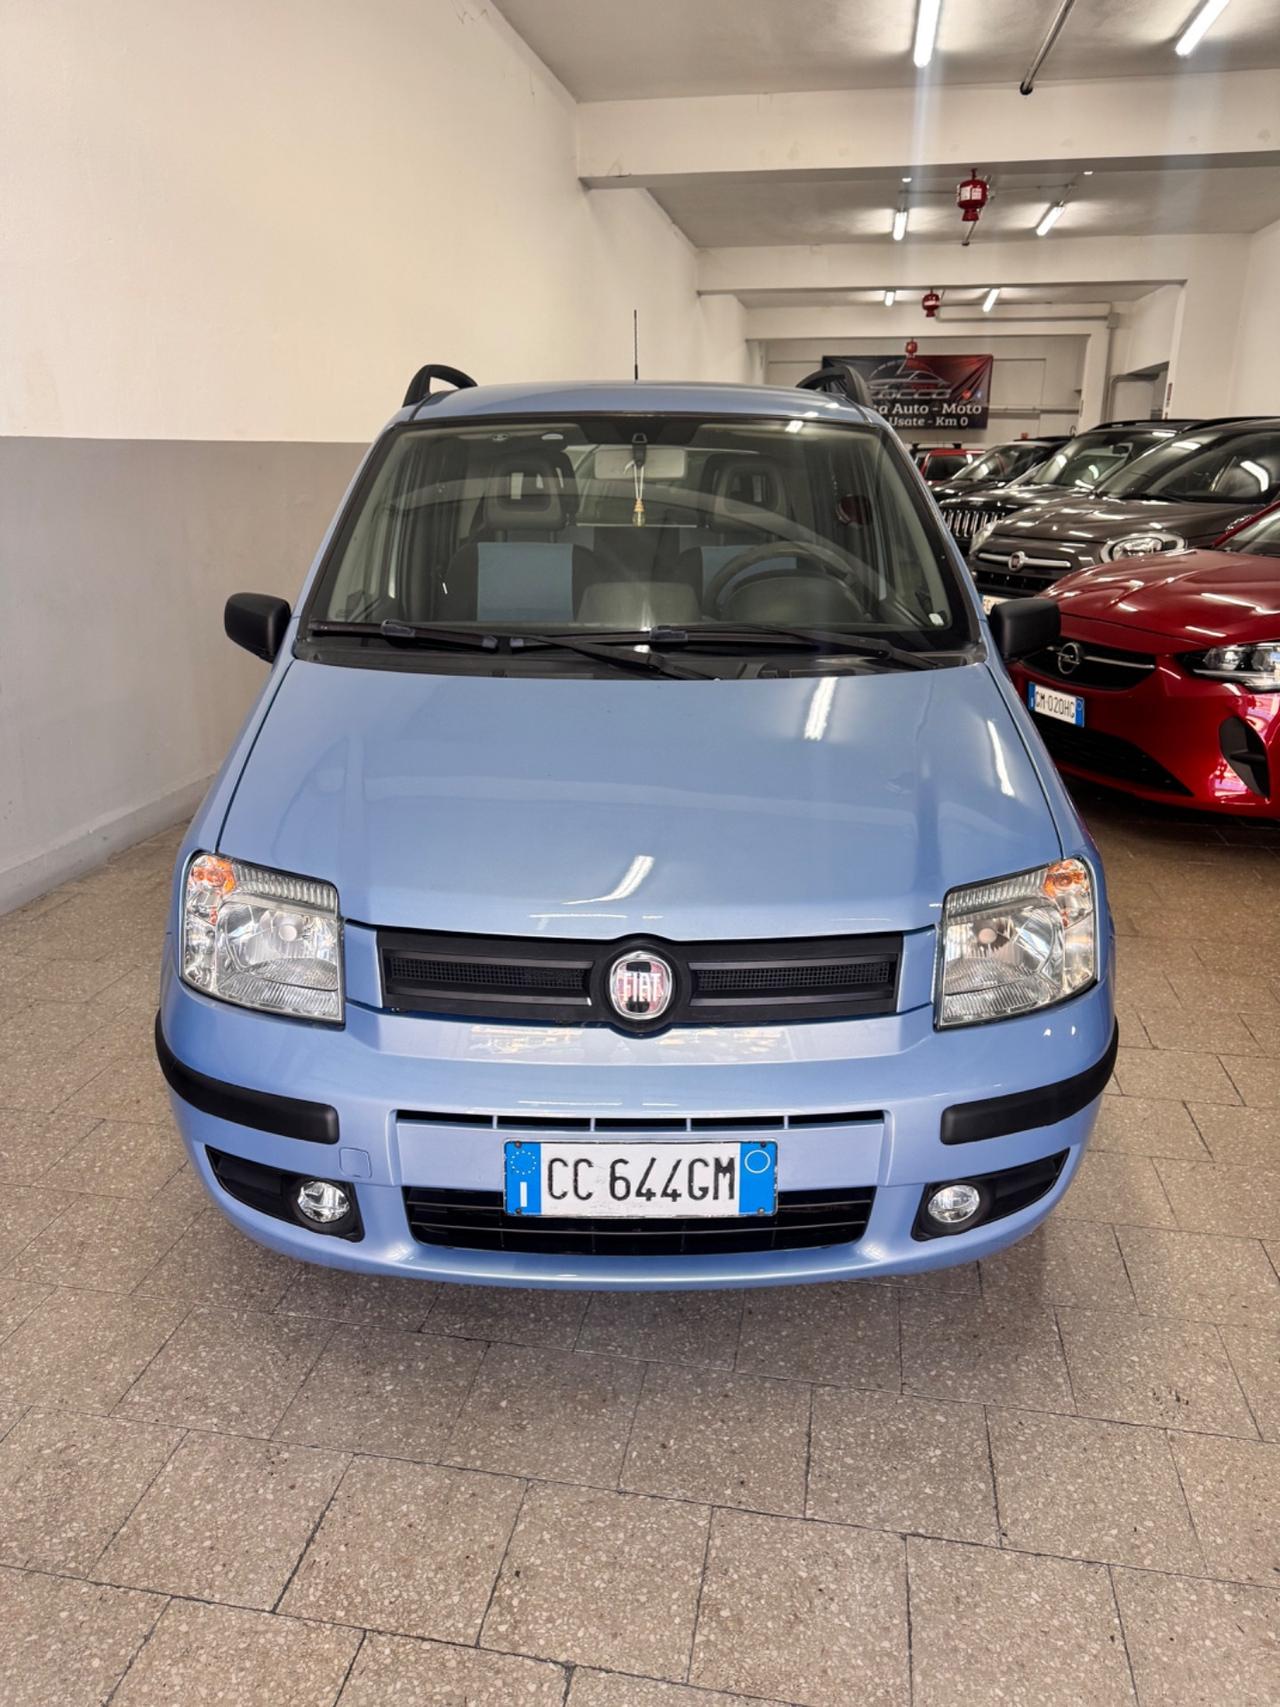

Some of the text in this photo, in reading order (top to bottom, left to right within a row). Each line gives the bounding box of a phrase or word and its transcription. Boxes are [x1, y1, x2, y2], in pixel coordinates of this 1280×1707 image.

[892, 403, 929, 415] Auto
[942, 403, 982, 415] Moto
[888, 416, 927, 427] Usate
[935, 416, 958, 427] Km
[960, 416, 969, 427] 0
[623, 972, 661, 1003] FIAT
[547, 1157, 736, 1202] CC 644GM
